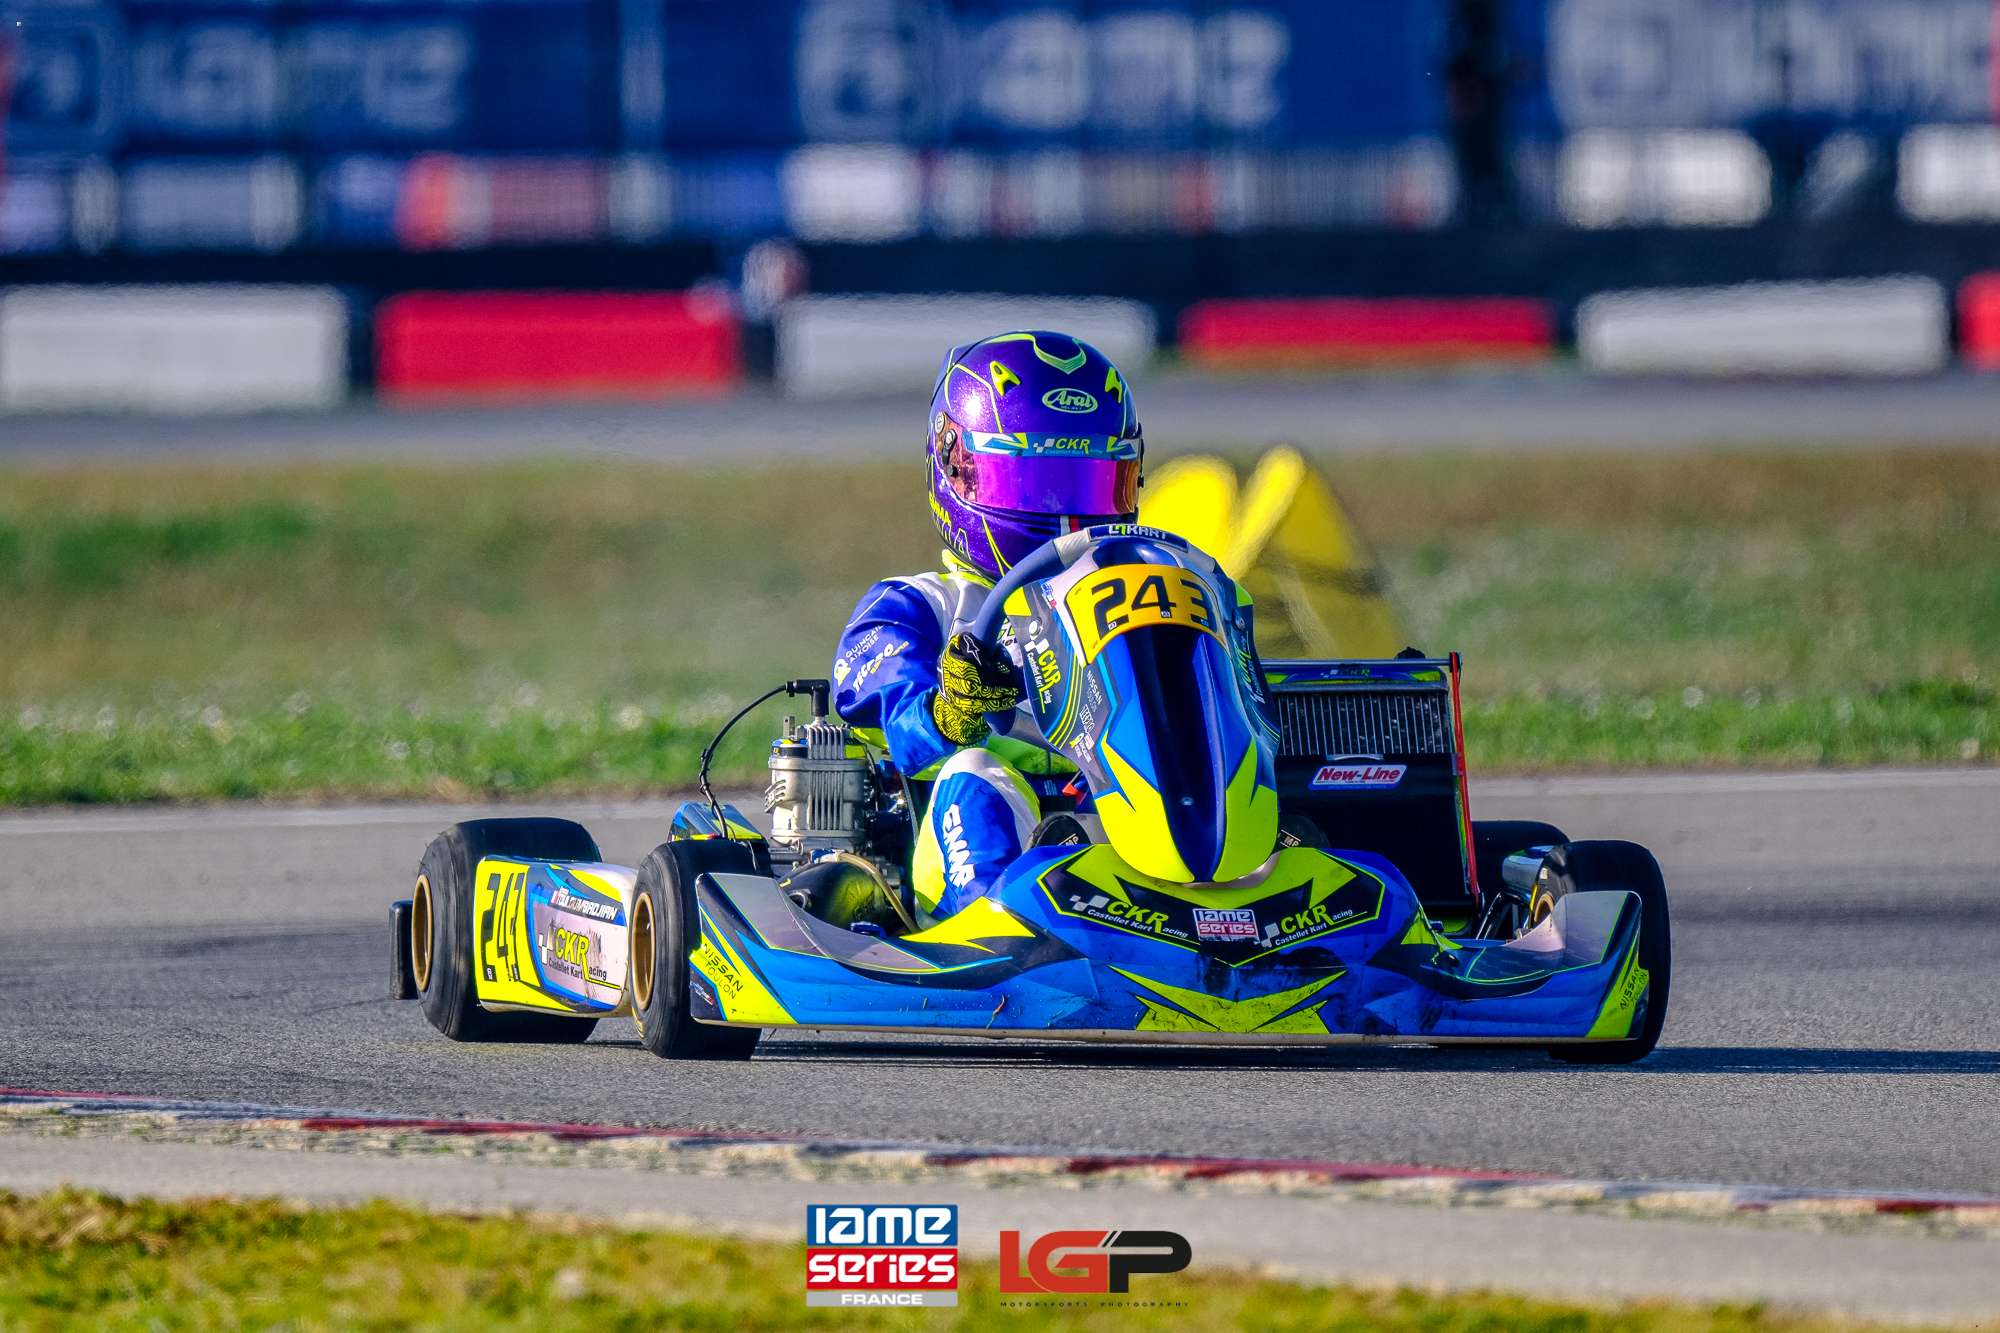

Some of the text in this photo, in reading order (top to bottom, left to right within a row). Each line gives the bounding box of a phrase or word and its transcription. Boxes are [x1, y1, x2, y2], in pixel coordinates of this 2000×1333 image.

[1047, 390, 1092, 408] Arai
[1056, 438, 1091, 455] CKR
[1091, 575, 1218, 641] 243
[1038, 650, 1061, 692] CKR
[1318, 767, 1400, 781] New-Line
[1087, 909, 1189, 938] Castellet Kart acing
[1107, 901, 1169, 934] CKR
[1199, 923, 1255, 934] series
[1275, 909, 1353, 946] Castellet Kart acing
[1281, 904, 1335, 934] CKR
[555, 927, 590, 980] CKR
[704, 943, 743, 992] NISSAN
[570, 966, 583, 979] Kart
[588, 966, 607, 981] acing
[705, 961, 736, 999] TOULON
[1620, 967, 1640, 1010] NISSAN
